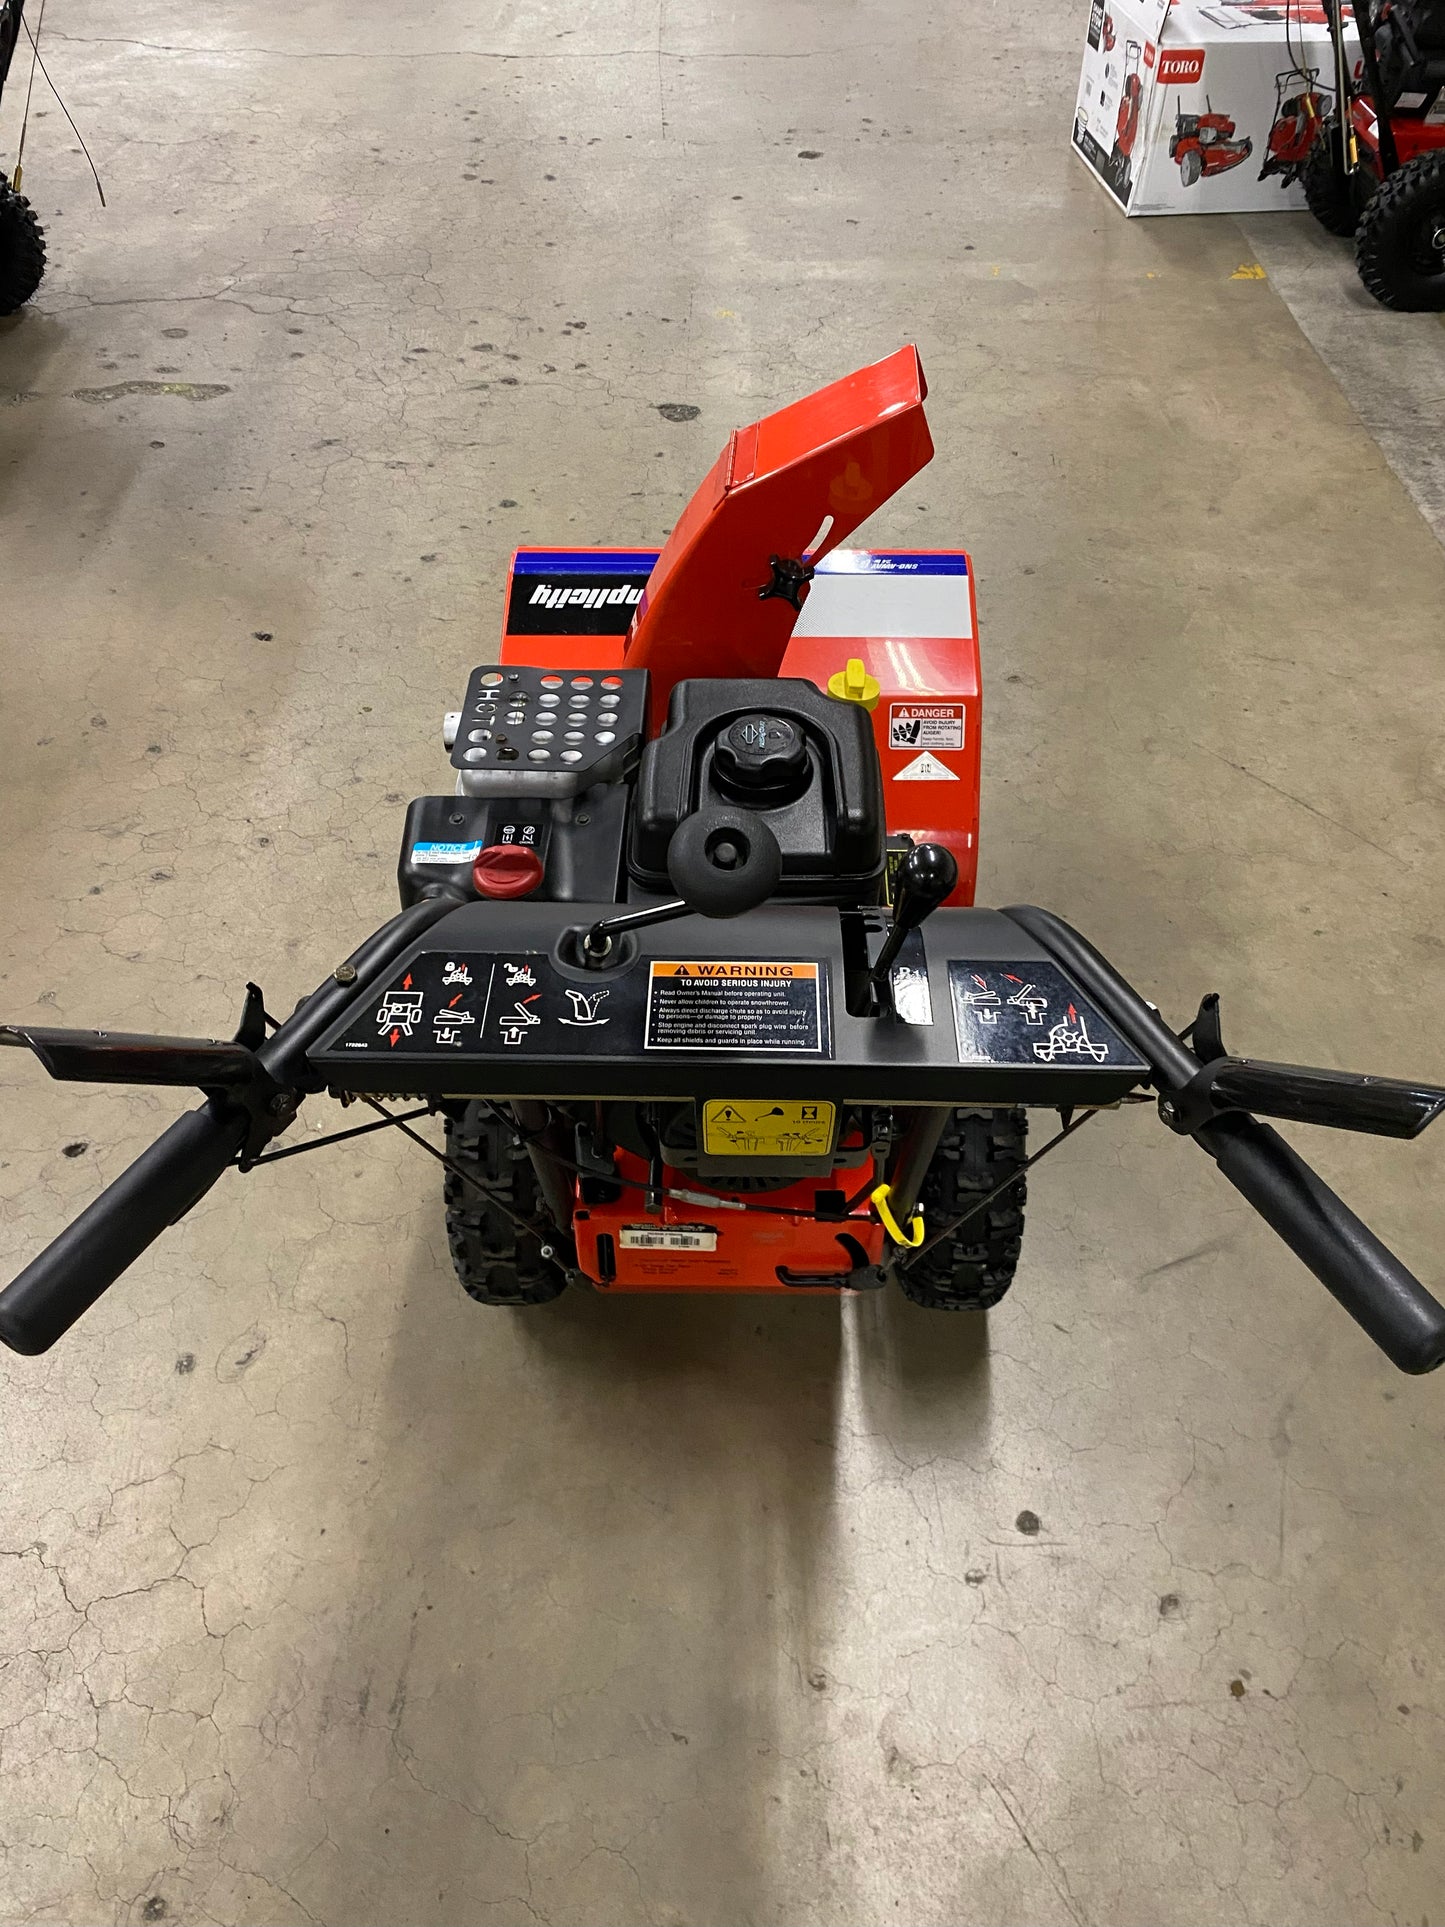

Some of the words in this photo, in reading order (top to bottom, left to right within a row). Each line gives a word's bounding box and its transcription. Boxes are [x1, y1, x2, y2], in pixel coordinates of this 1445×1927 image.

[1162, 60, 1200, 74] TORO
[912, 709, 954, 717] DANGER
[698, 966, 793, 976] WARNING
